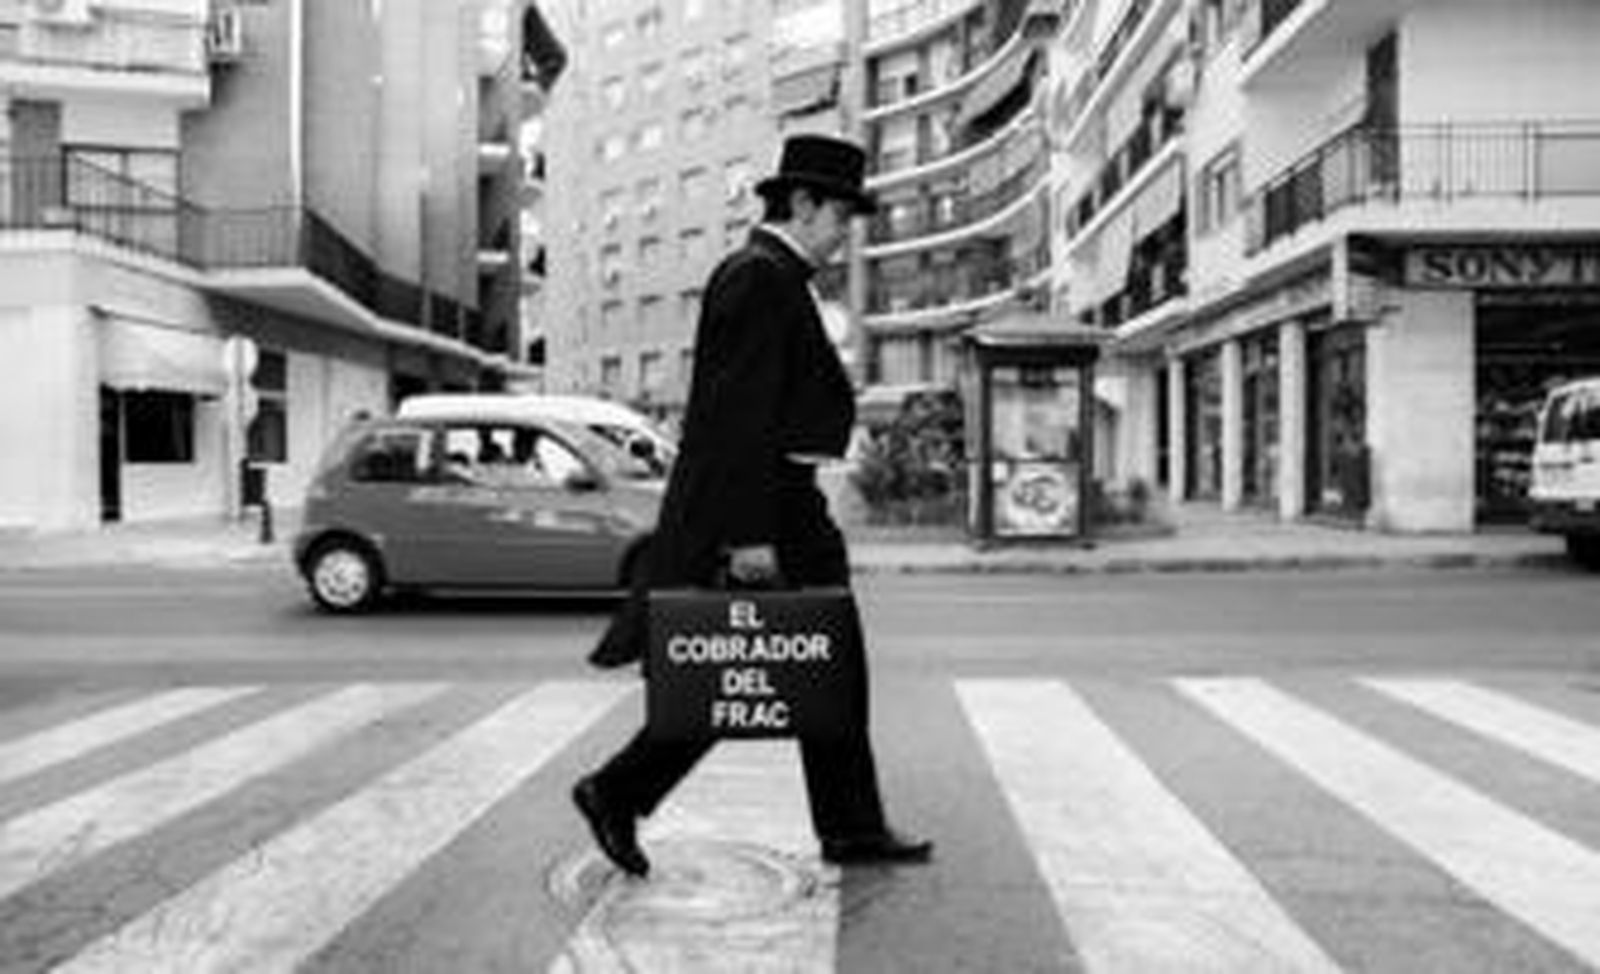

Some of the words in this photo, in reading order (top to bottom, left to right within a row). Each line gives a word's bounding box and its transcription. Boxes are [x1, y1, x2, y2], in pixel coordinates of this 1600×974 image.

[730, 602, 764, 627] EL
[667, 635, 830, 662] COBRADOR
[723, 669, 776, 695] DEL
[711, 702, 790, 727] FRAC
